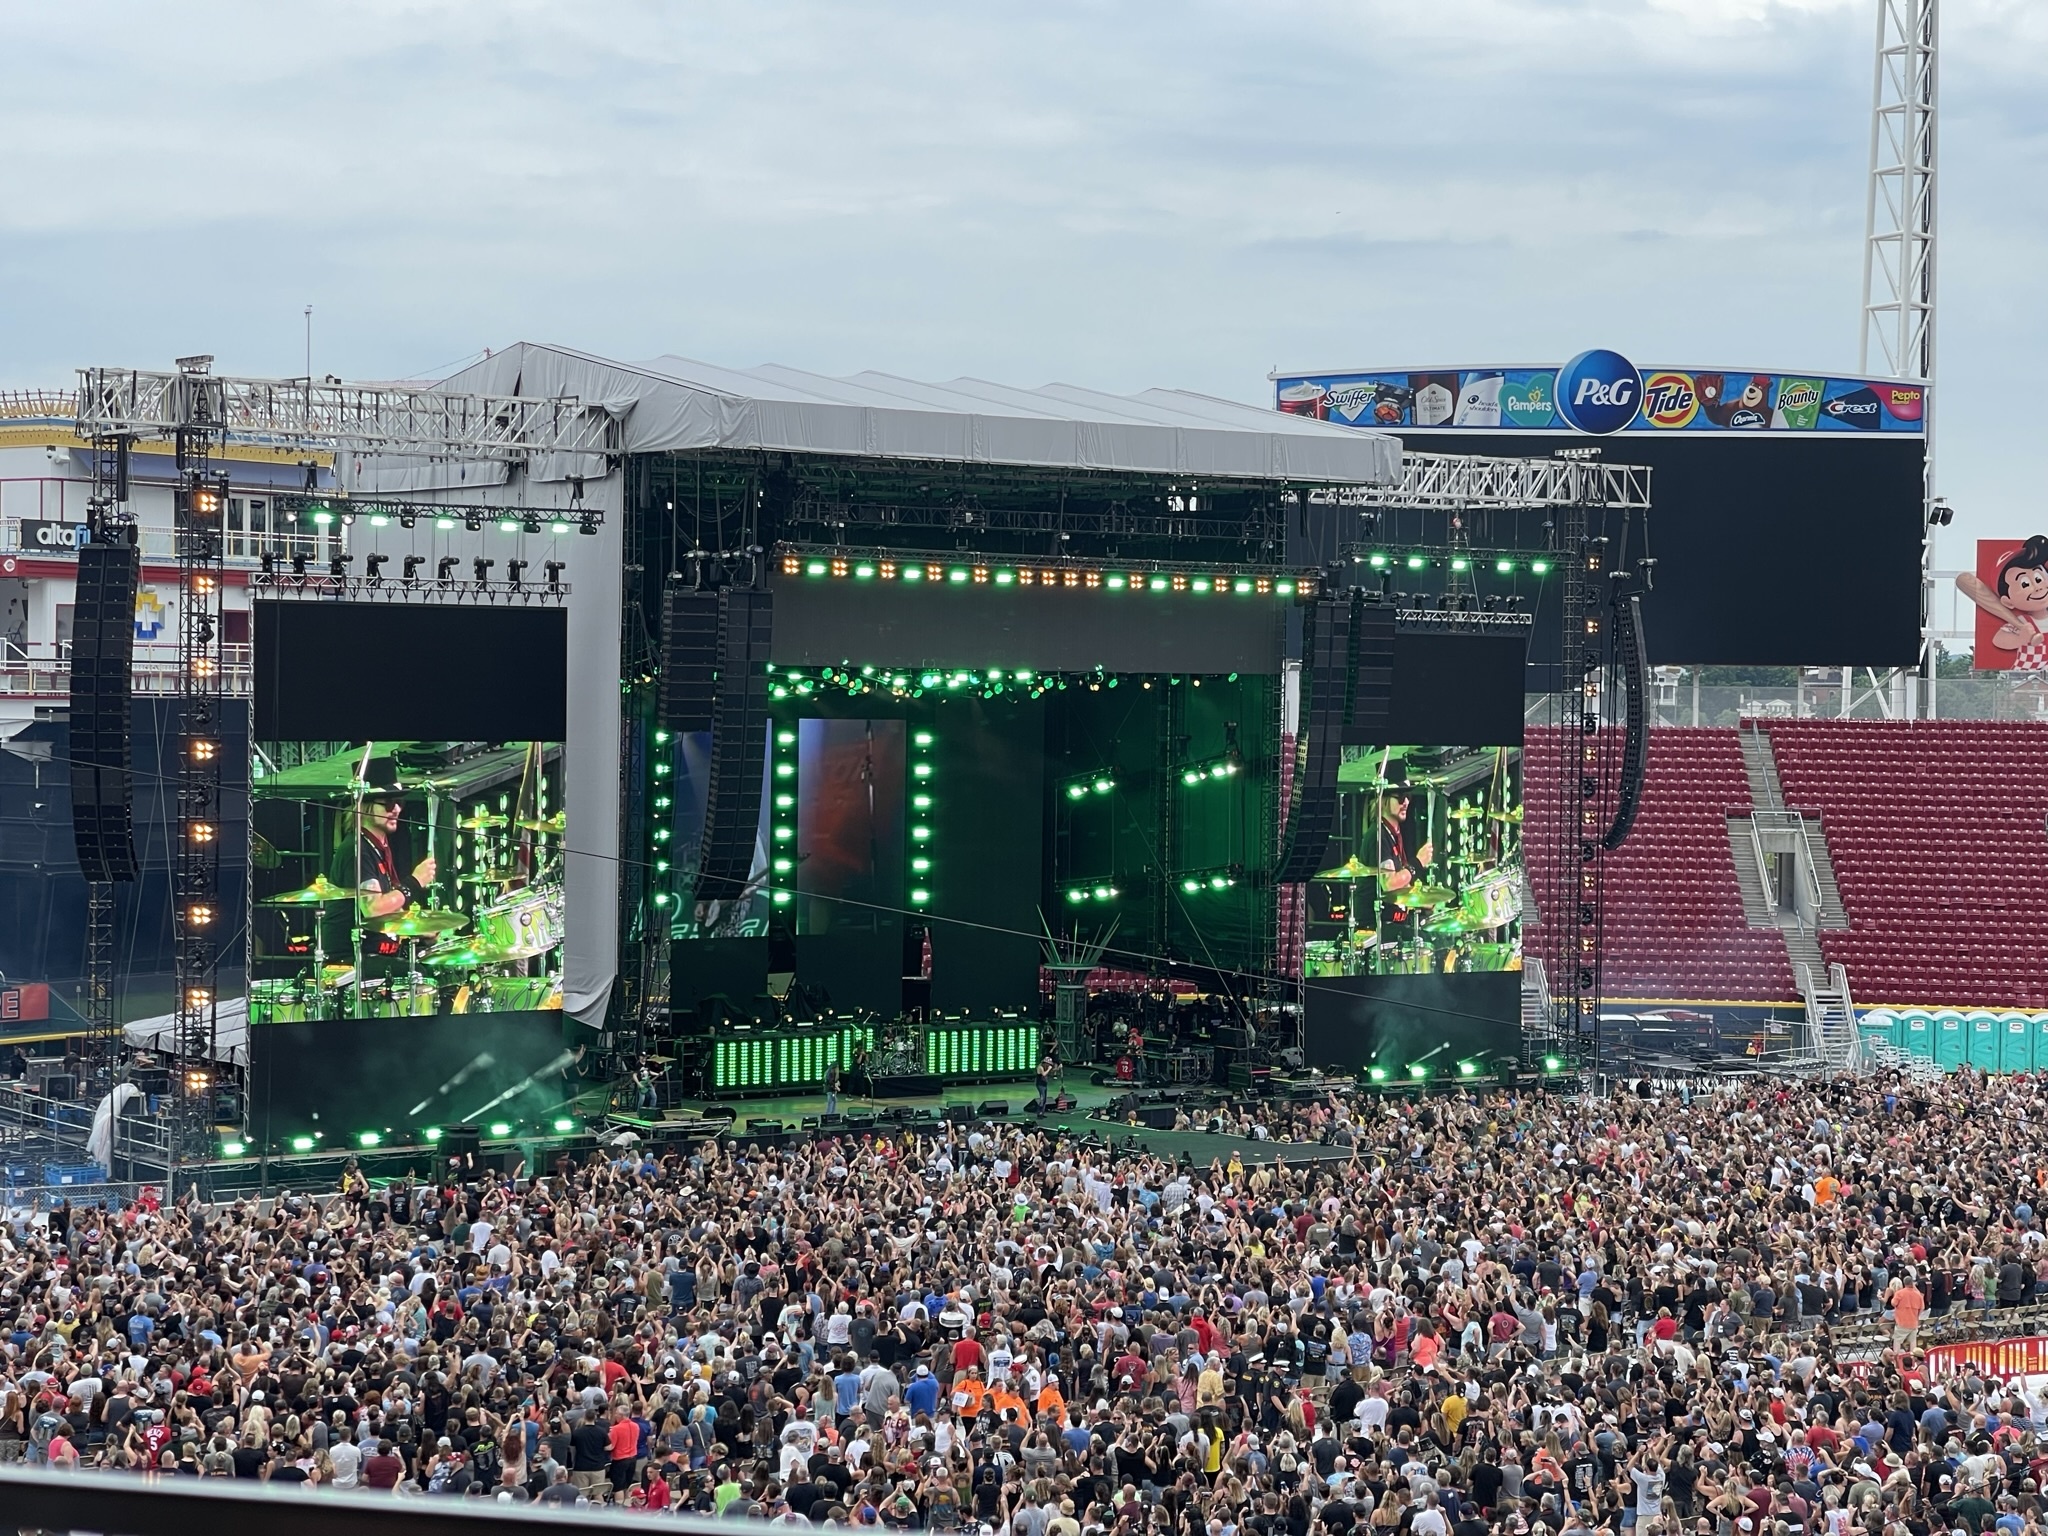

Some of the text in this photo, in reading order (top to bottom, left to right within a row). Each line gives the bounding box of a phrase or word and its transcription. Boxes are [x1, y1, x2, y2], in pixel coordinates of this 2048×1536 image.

[1323, 388, 1375, 409] Swiffer
[1573, 378, 1633, 405] P&G
[1777, 389, 1819, 410] Bounty
[1891, 390, 1920, 403] Pepto
[1507, 396, 1552, 413] Pampers
[1645, 385, 1694, 419] Tide
[1827, 401, 1878, 414] Crest
[150, 1436, 158, 1451] 5
